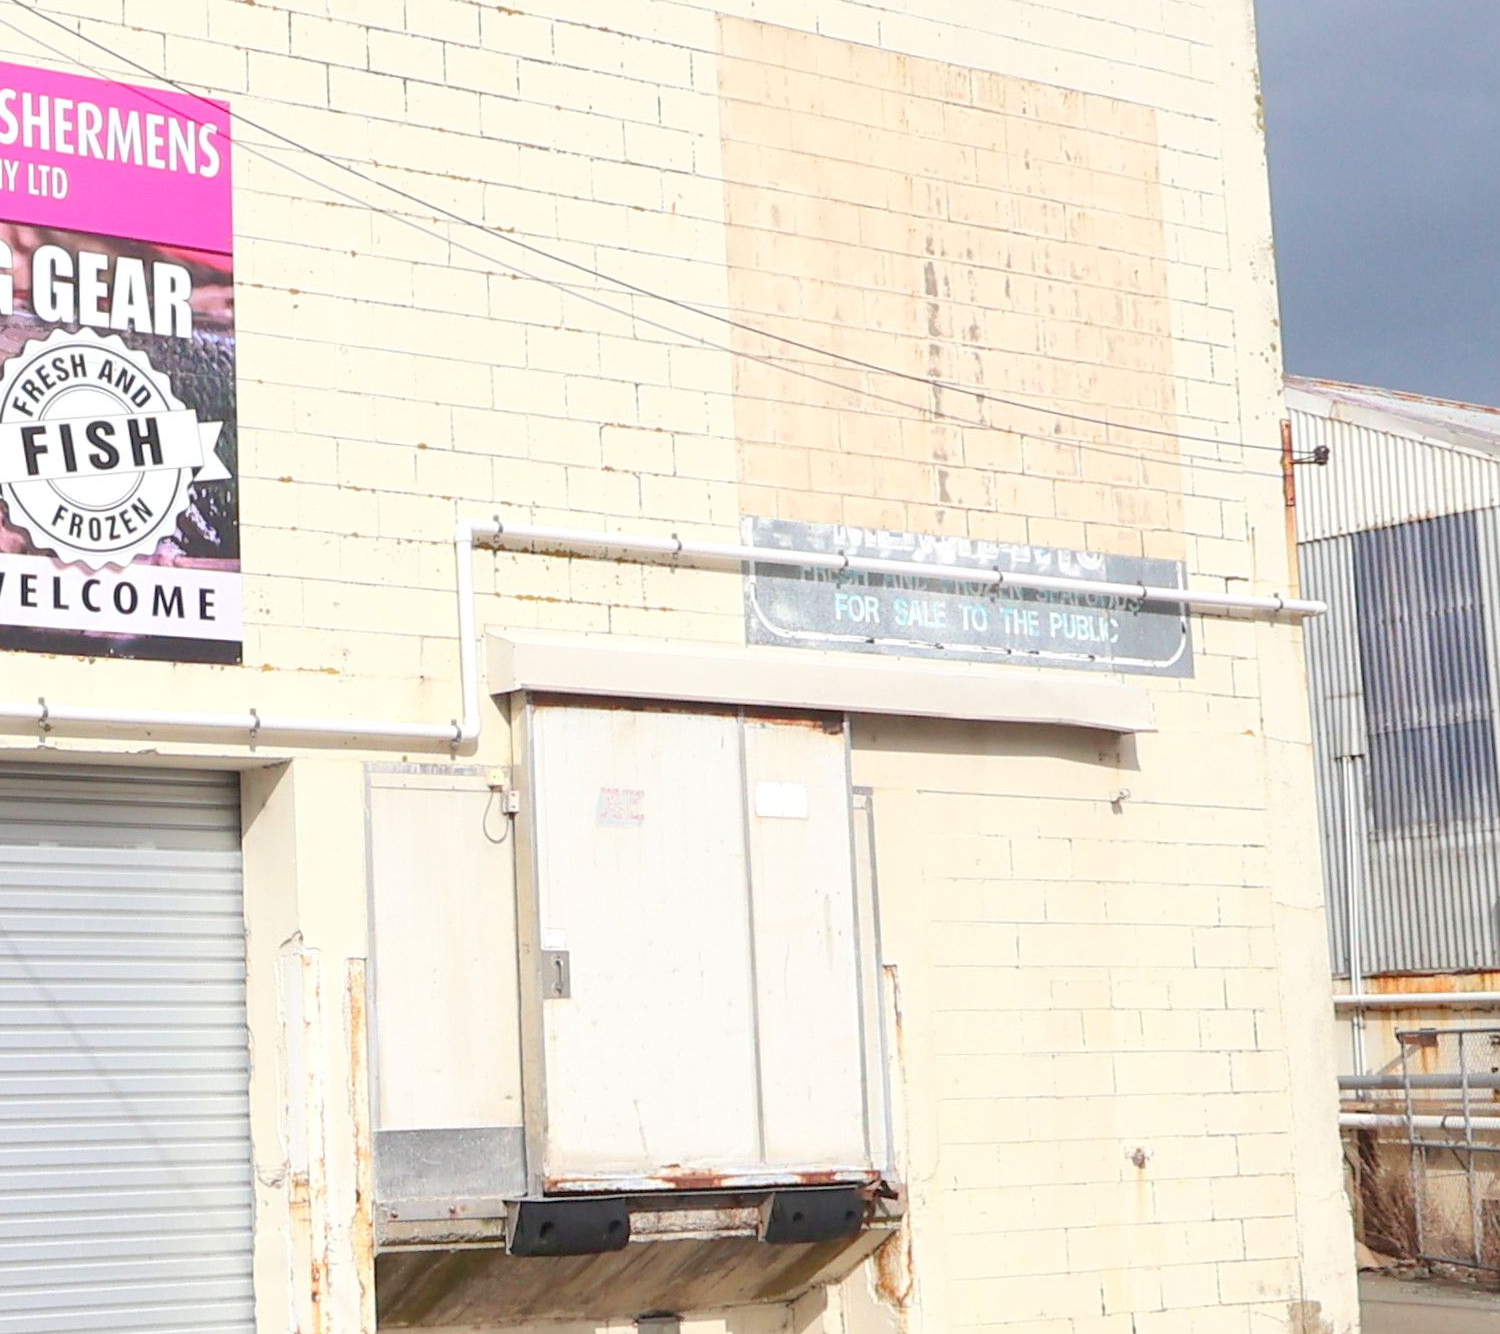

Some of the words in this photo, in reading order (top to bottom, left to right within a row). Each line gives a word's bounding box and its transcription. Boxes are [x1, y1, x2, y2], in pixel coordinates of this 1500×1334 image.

[27, 161, 69, 200] LTD
[31, 245, 194, 339] GEAR
[12, 353, 88, 417] FRESH
[97, 358, 152, 409] AND
[20, 417, 164, 477] FISH
[51, 497, 154, 542] FROZEN
[834, 592, 881, 624] FOR
[893, 597, 947, 630] SALE
[958, 602, 988, 633] TO
[1000, 606, 1041, 638] THE
[1049, 611, 1120, 644] PUBLIC
